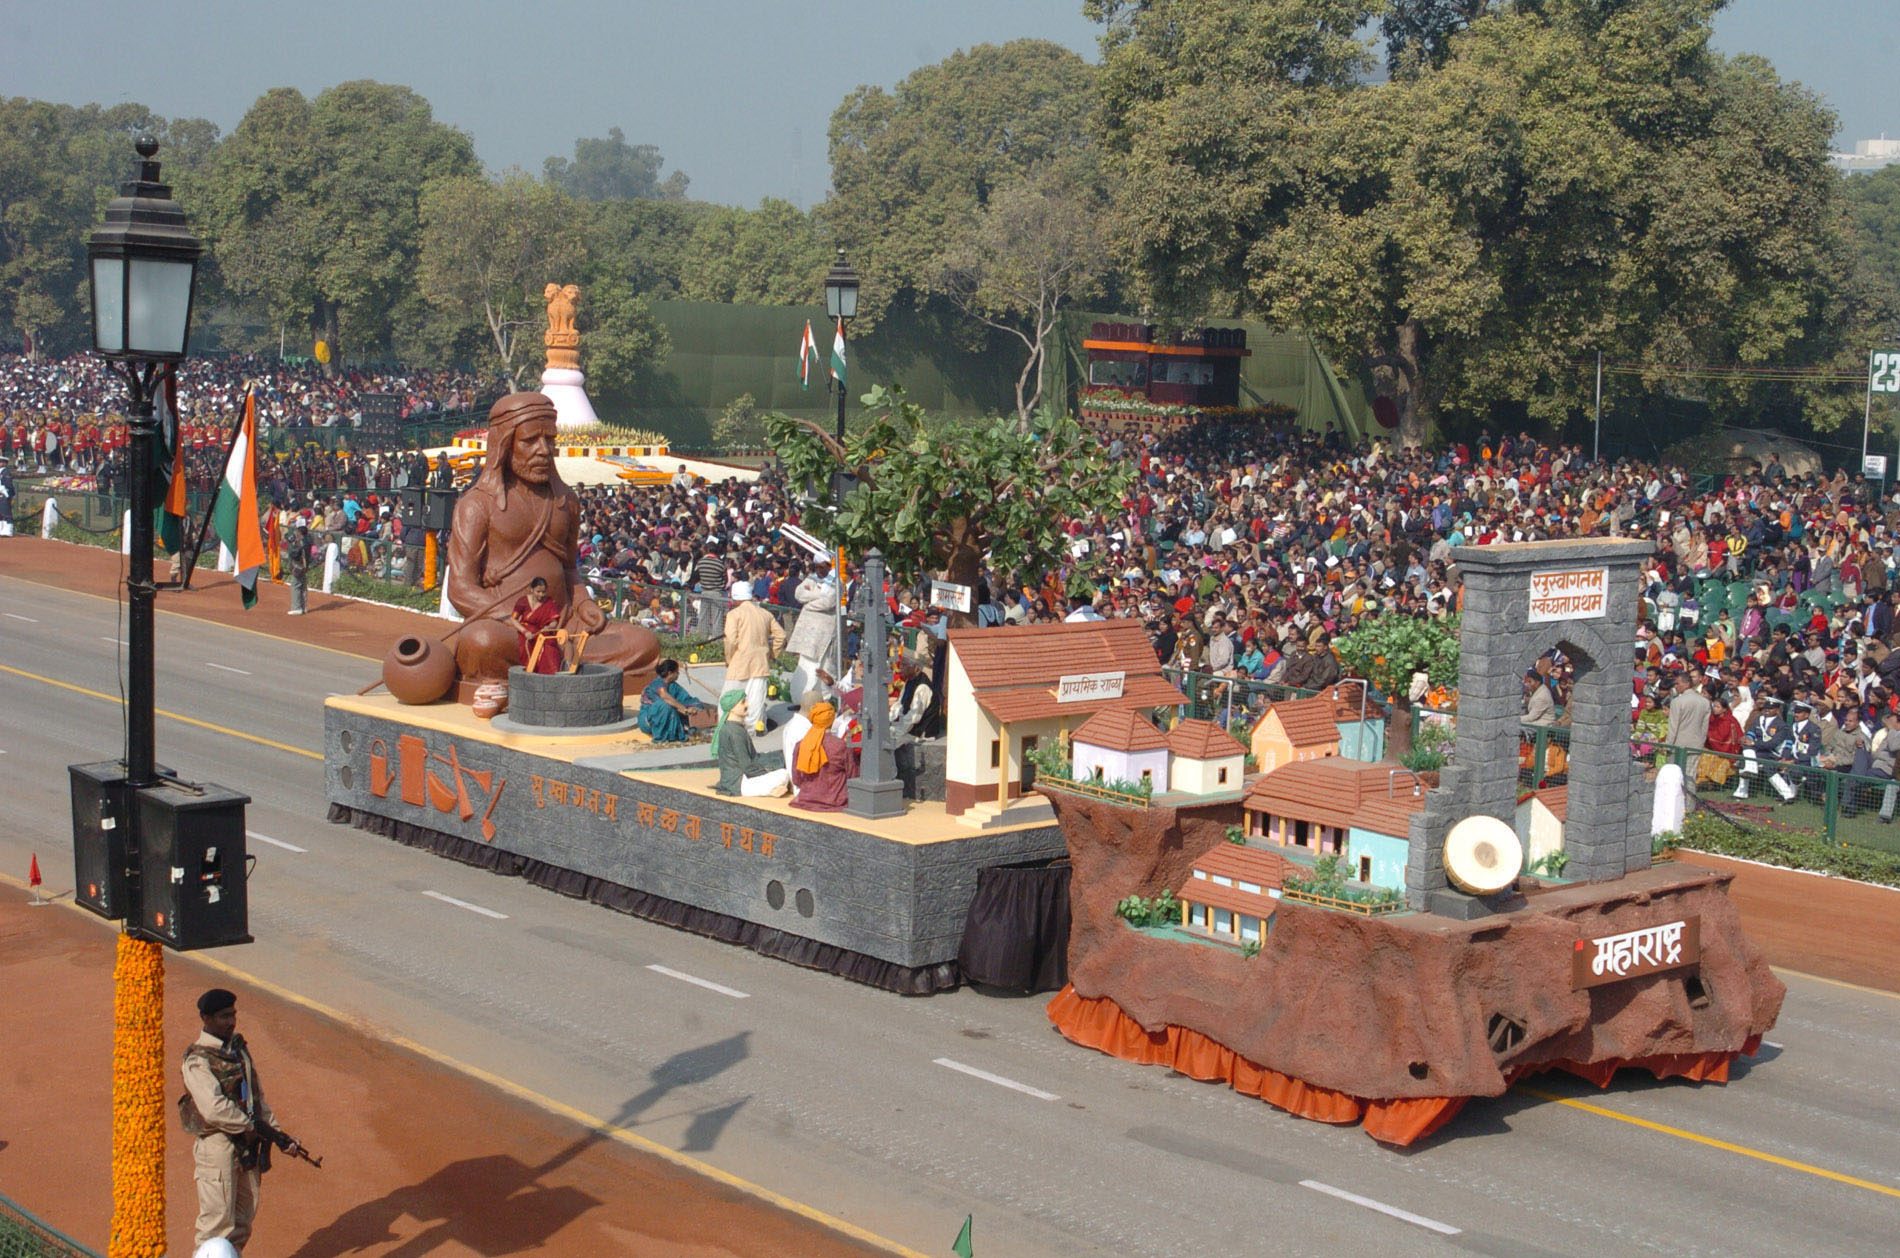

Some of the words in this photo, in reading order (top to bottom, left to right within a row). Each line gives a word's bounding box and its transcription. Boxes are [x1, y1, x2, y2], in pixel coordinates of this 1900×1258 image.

[1872, 353, 1900, 392] 23
[1532, 570, 1604, 597] सुस्वागतम्
[1531, 596, 1570, 616] स्वच्छता
[1571, 594, 1603, 613] प्रथम
[1591, 921, 1686, 976] महाराष्ट्र
